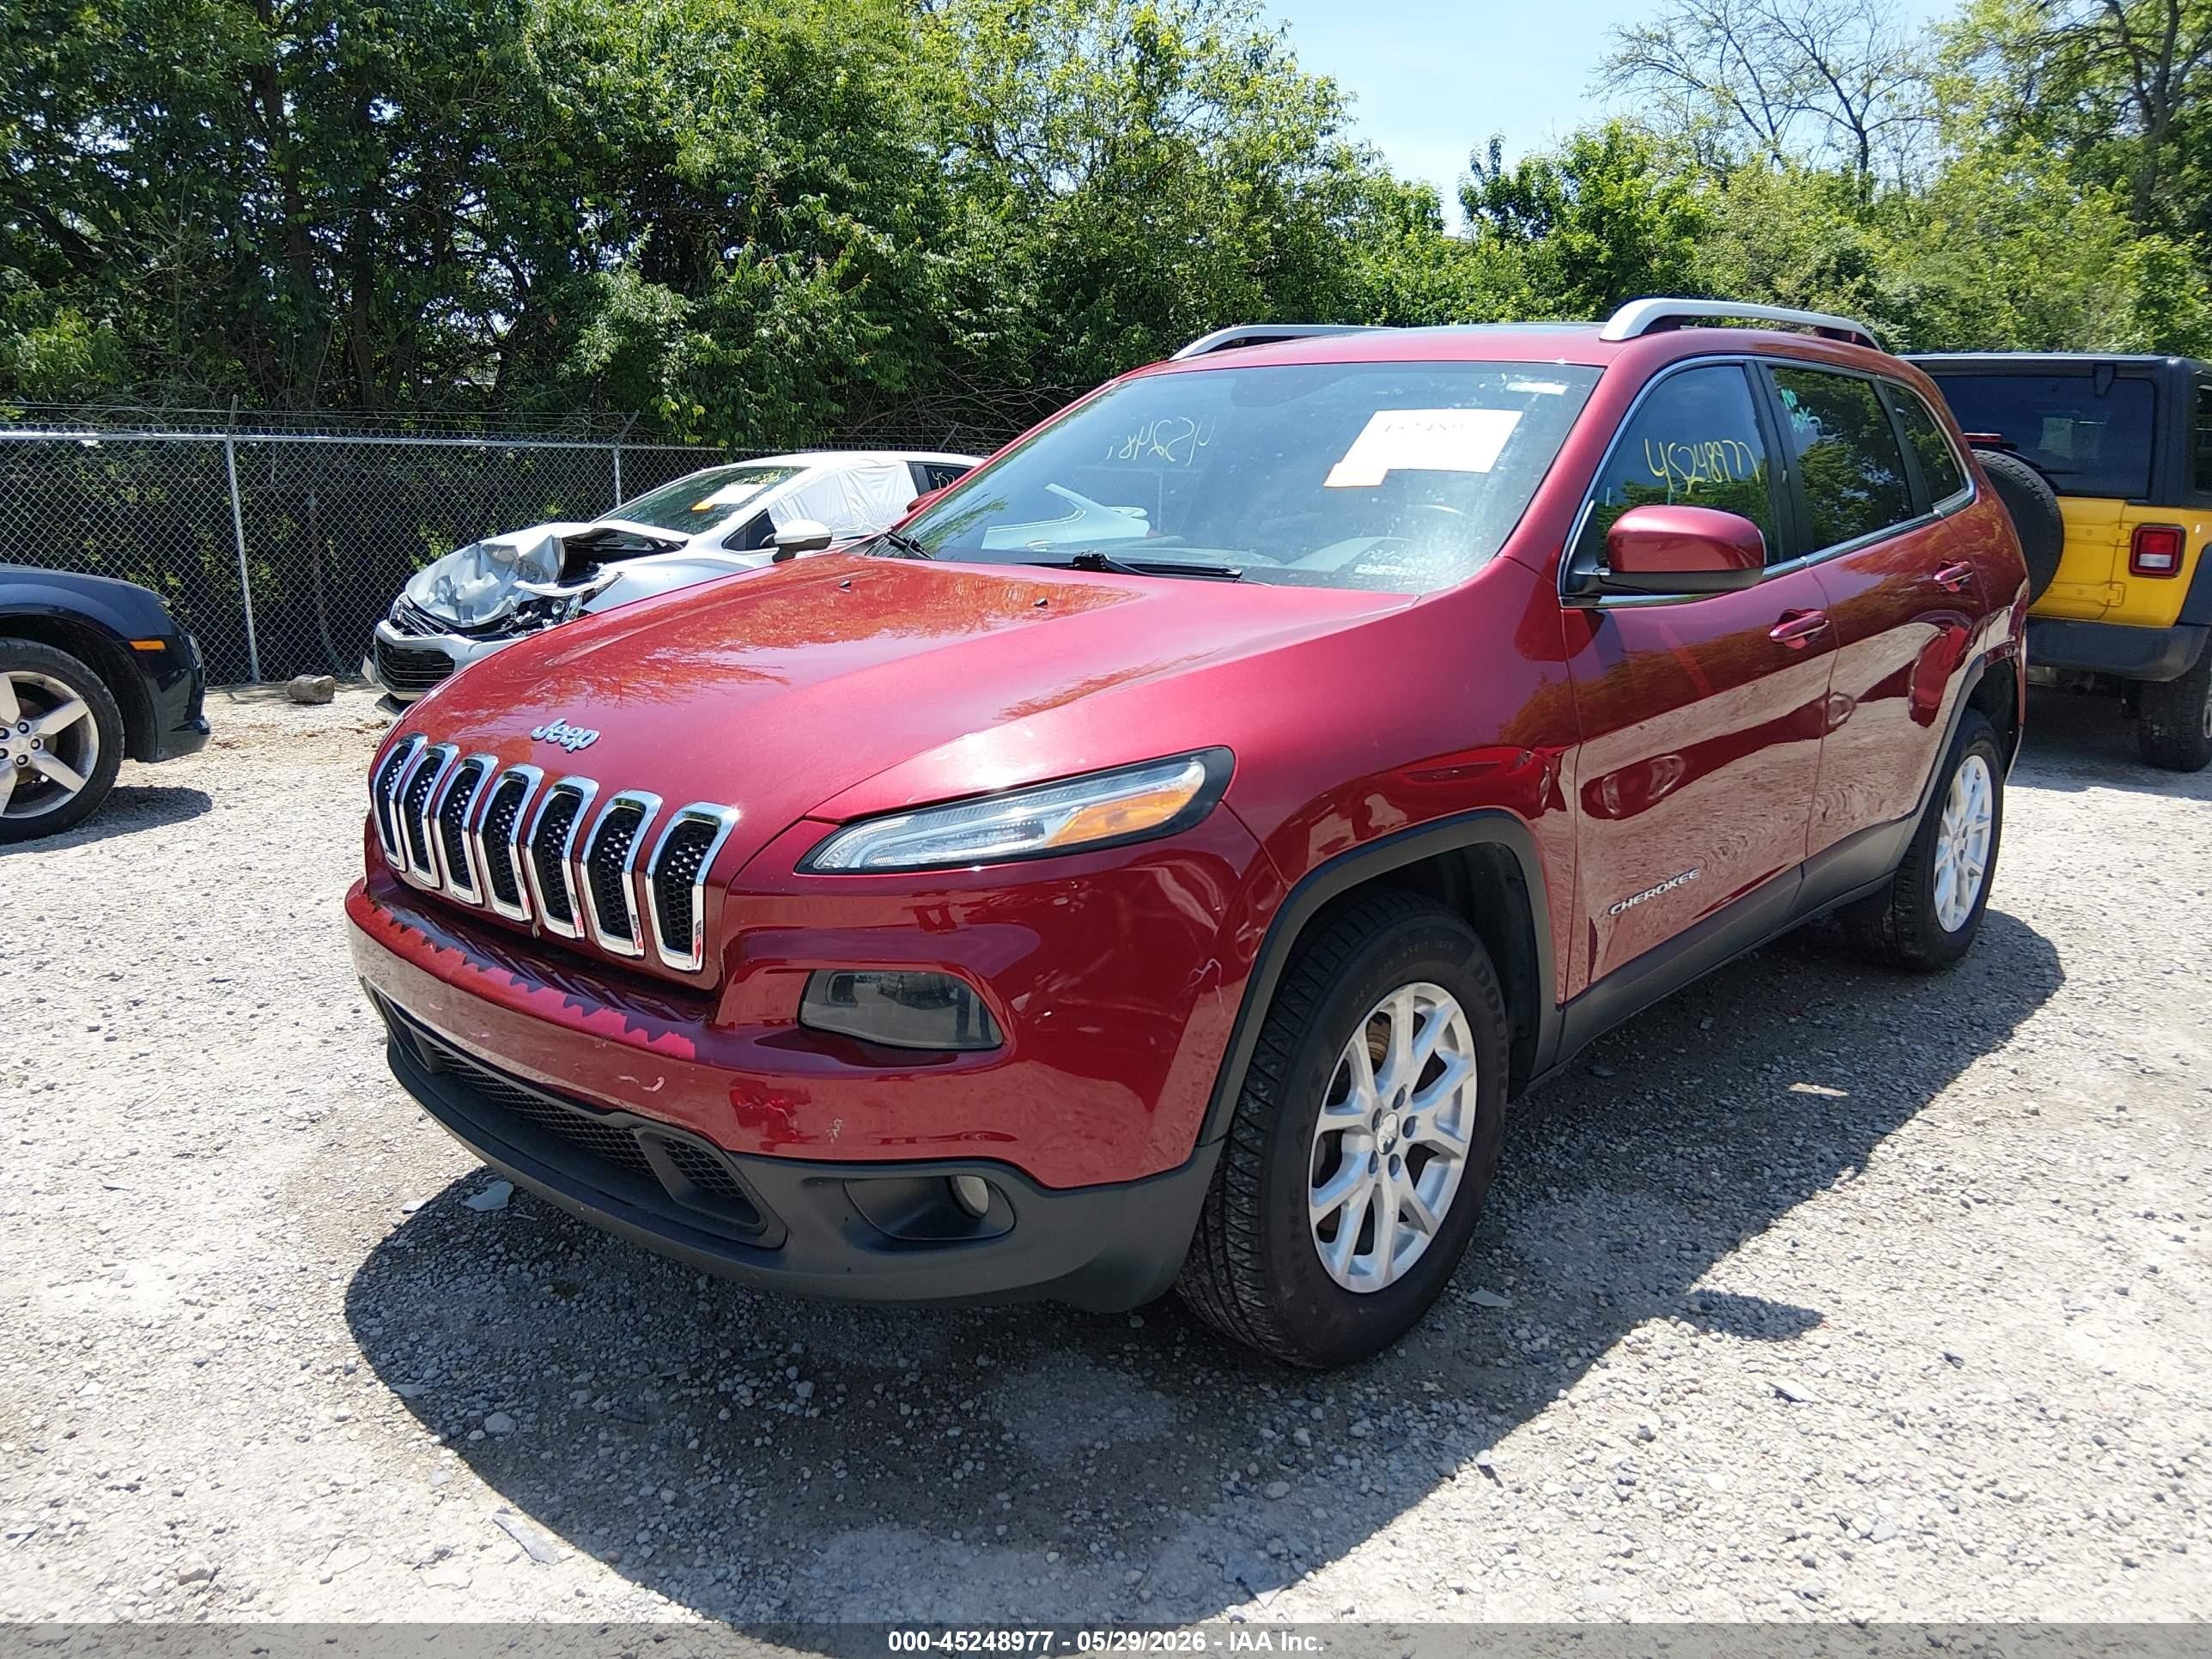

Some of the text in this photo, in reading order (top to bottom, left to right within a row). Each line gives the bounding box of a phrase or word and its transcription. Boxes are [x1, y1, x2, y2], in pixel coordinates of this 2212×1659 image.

[1644, 437, 1760, 495] 45248977
[530, 717, 601, 754] Jeep
[1607, 867, 1701, 916] CHEROKEE
